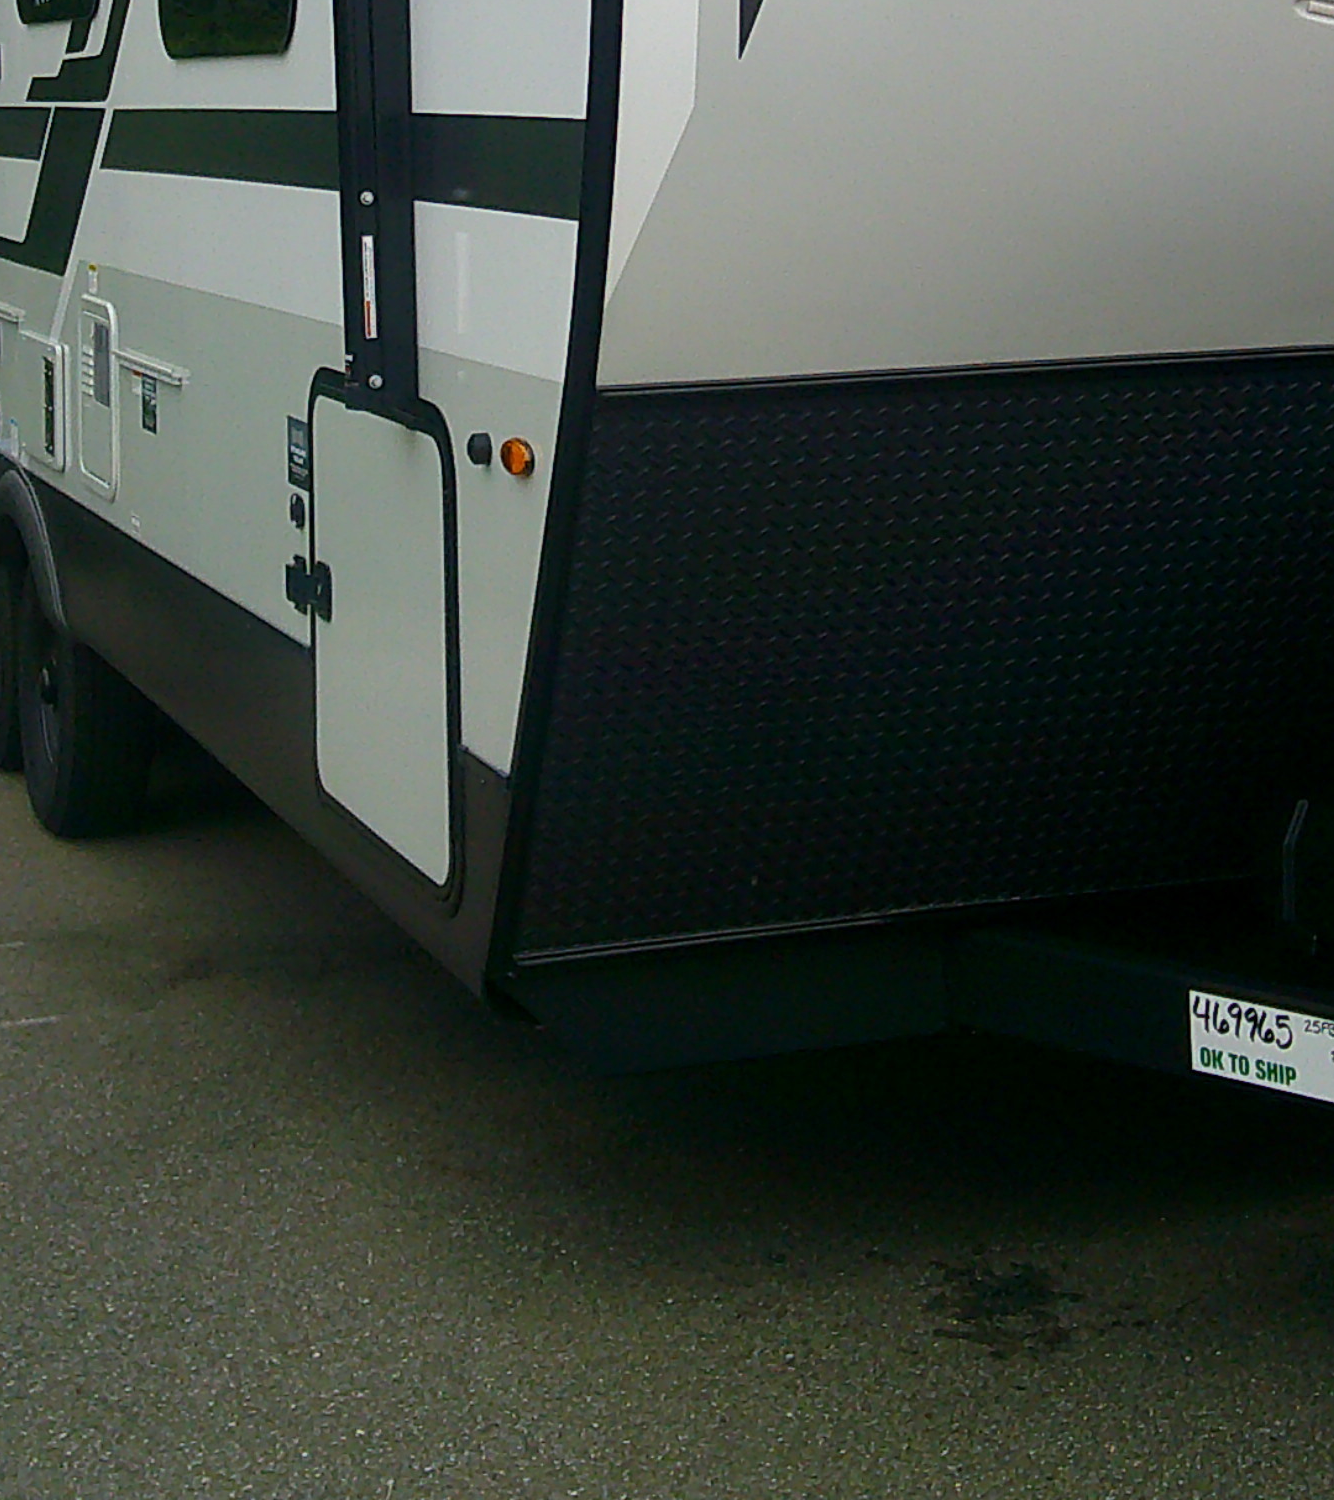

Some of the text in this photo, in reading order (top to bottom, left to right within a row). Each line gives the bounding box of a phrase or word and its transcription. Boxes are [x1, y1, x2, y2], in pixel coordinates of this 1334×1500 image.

[1192, 995, 1294, 1050] 469965
[1199, 1046, 1297, 1087] OK TO SHIP
